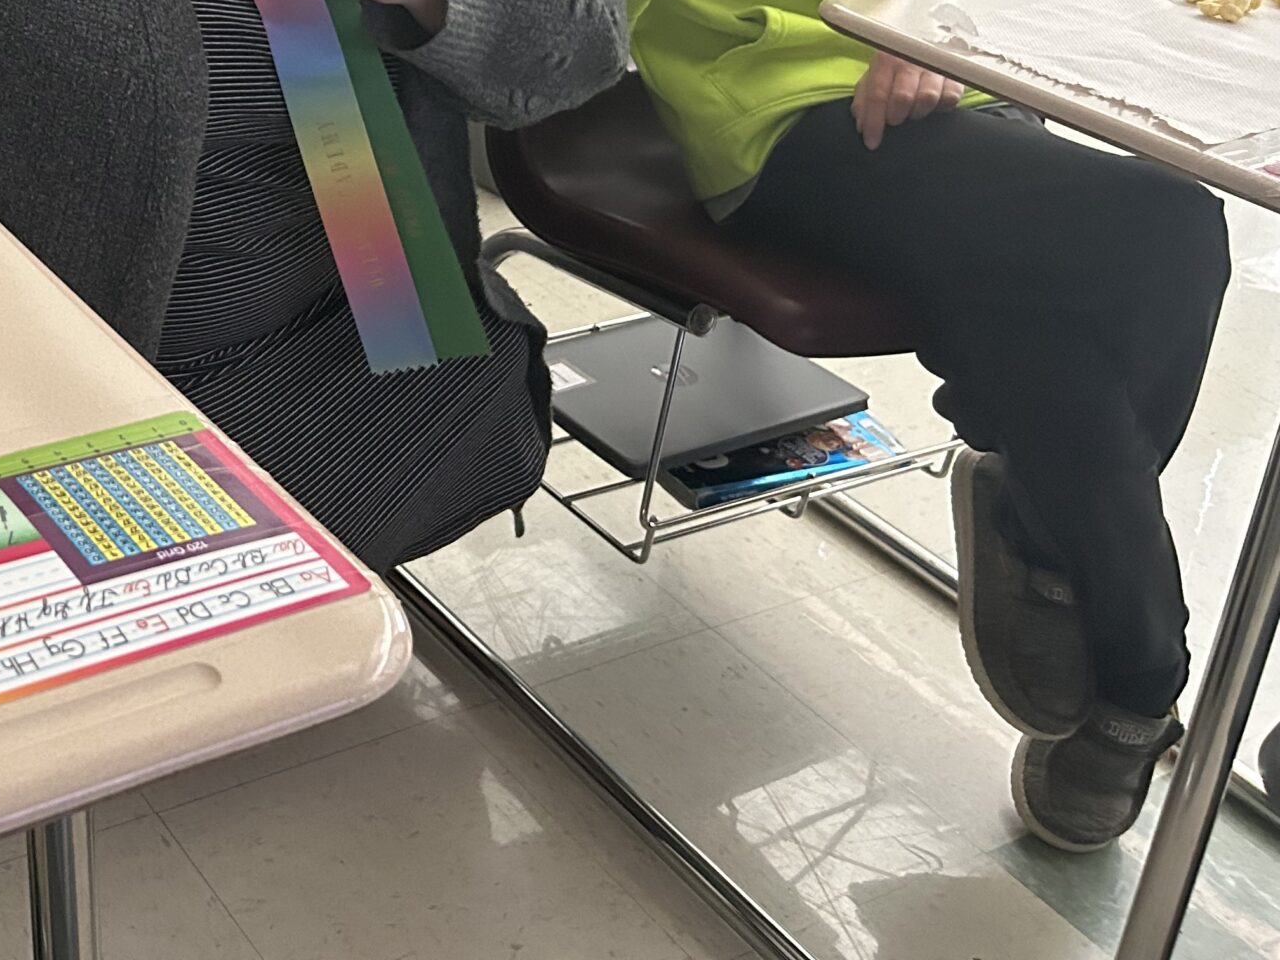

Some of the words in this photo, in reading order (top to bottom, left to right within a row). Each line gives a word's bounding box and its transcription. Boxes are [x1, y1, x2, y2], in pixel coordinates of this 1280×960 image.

[156, 546, 185, 559] Grid
[186, 541, 208, 551] 120
[273, 538, 305, 555] Aa
[198, 558, 227, 575] Cc
[233, 549, 266, 568] Bb
[156, 566, 190, 590] Dd
[298, 566, 331, 583] Aa
[67, 579, 116, 612] Ff
[123, 578, 151, 597] Ee
[259, 577, 295, 596] Bb
[26, 593, 69, 619] Gg
[217, 590, 250, 608] Cc
[175, 601, 212, 624] Dd
[135, 613, 170, 634] Ee
[38, 628, 85, 659] Gg
[98, 625, 128, 650] Ff
[0, 652, 39, 675] Hh
